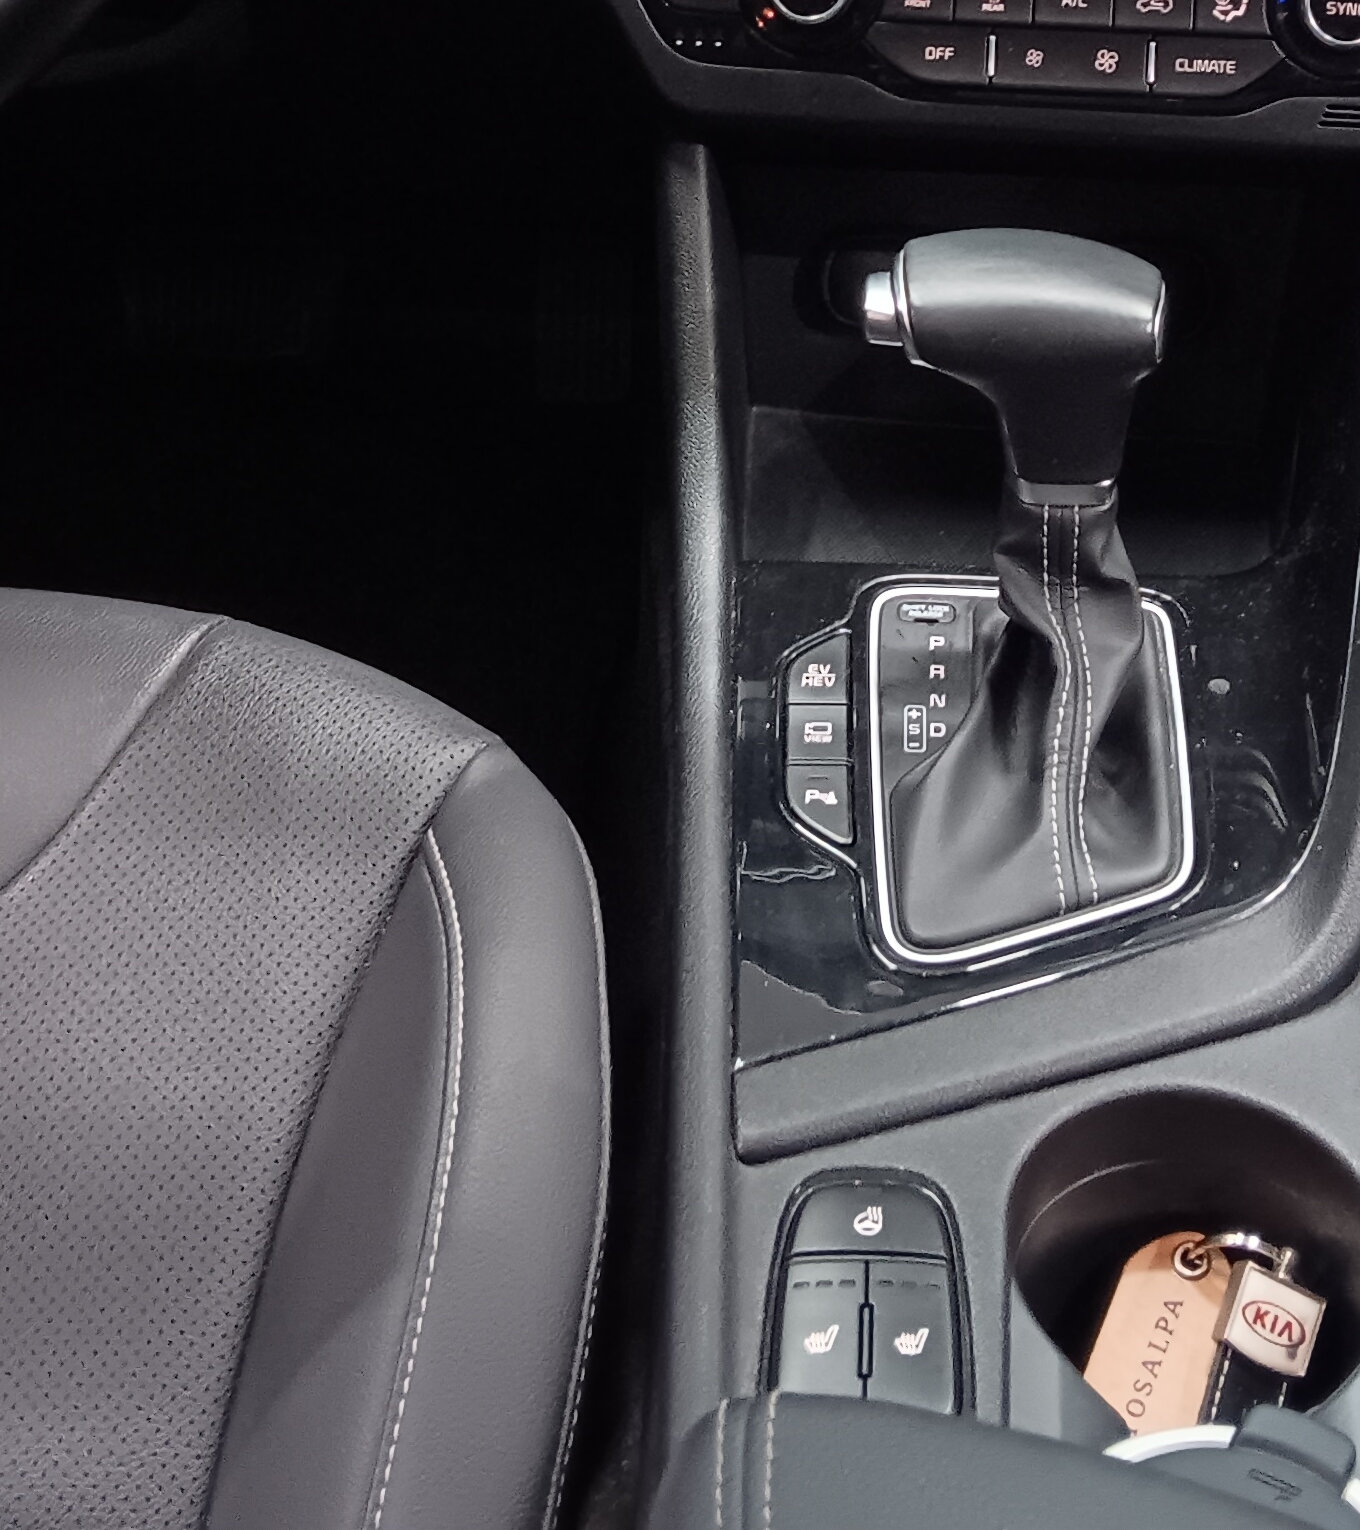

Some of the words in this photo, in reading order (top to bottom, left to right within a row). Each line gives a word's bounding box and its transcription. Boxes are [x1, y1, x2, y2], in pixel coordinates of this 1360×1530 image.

[924, 46, 955, 60] OFF
[1175, 57, 1236, 74] CLIMATE
[929, 635, 946, 651] P
[807, 663, 831, 674] EV
[929, 664, 945, 679] R
[800, 675, 836, 687] HEV
[929, 693, 947, 708] N
[908, 723, 921, 735] S
[929, 722, 947, 738] D
[1252, 1305, 1294, 1342] KIA
[1125, 1298, 1185, 1438] OSALPA
